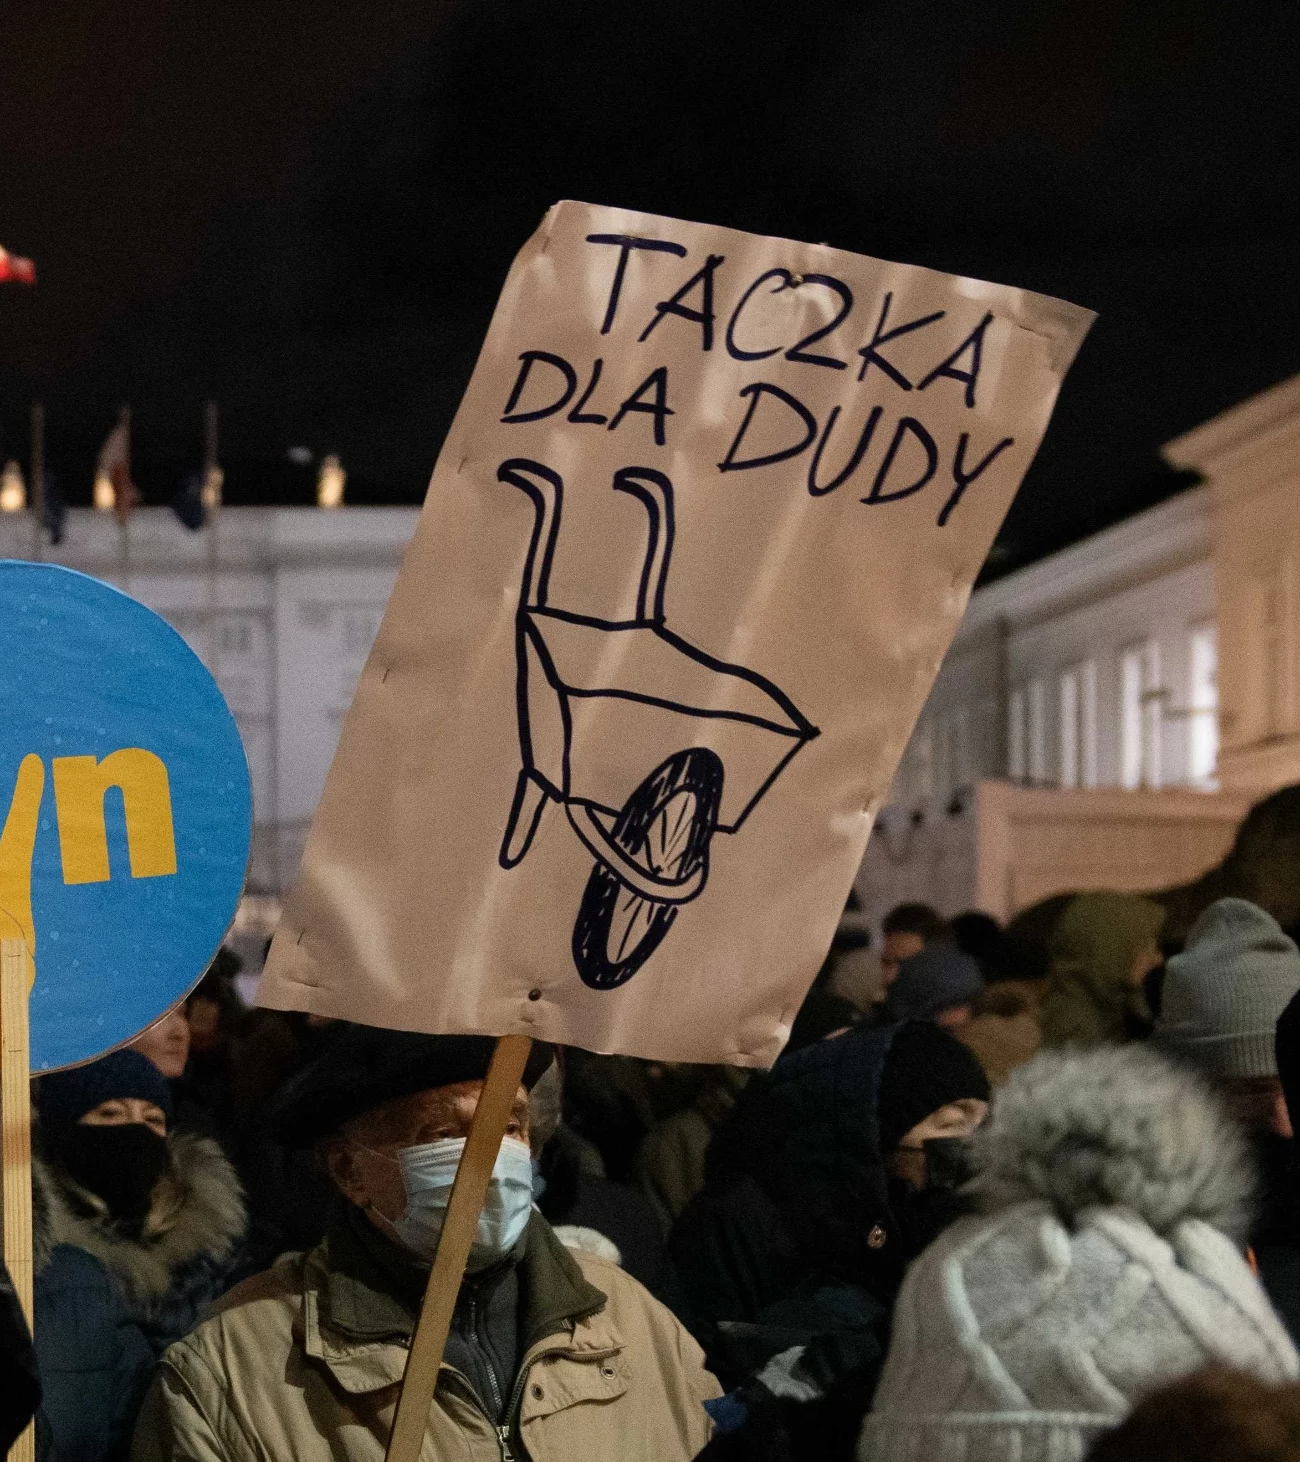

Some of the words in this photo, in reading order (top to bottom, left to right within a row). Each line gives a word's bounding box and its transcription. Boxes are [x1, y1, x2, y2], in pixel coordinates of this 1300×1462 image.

[586, 234, 993, 409] TACZKA
[500, 350, 675, 446] DLA
[717, 382, 1015, 527] DUDY
